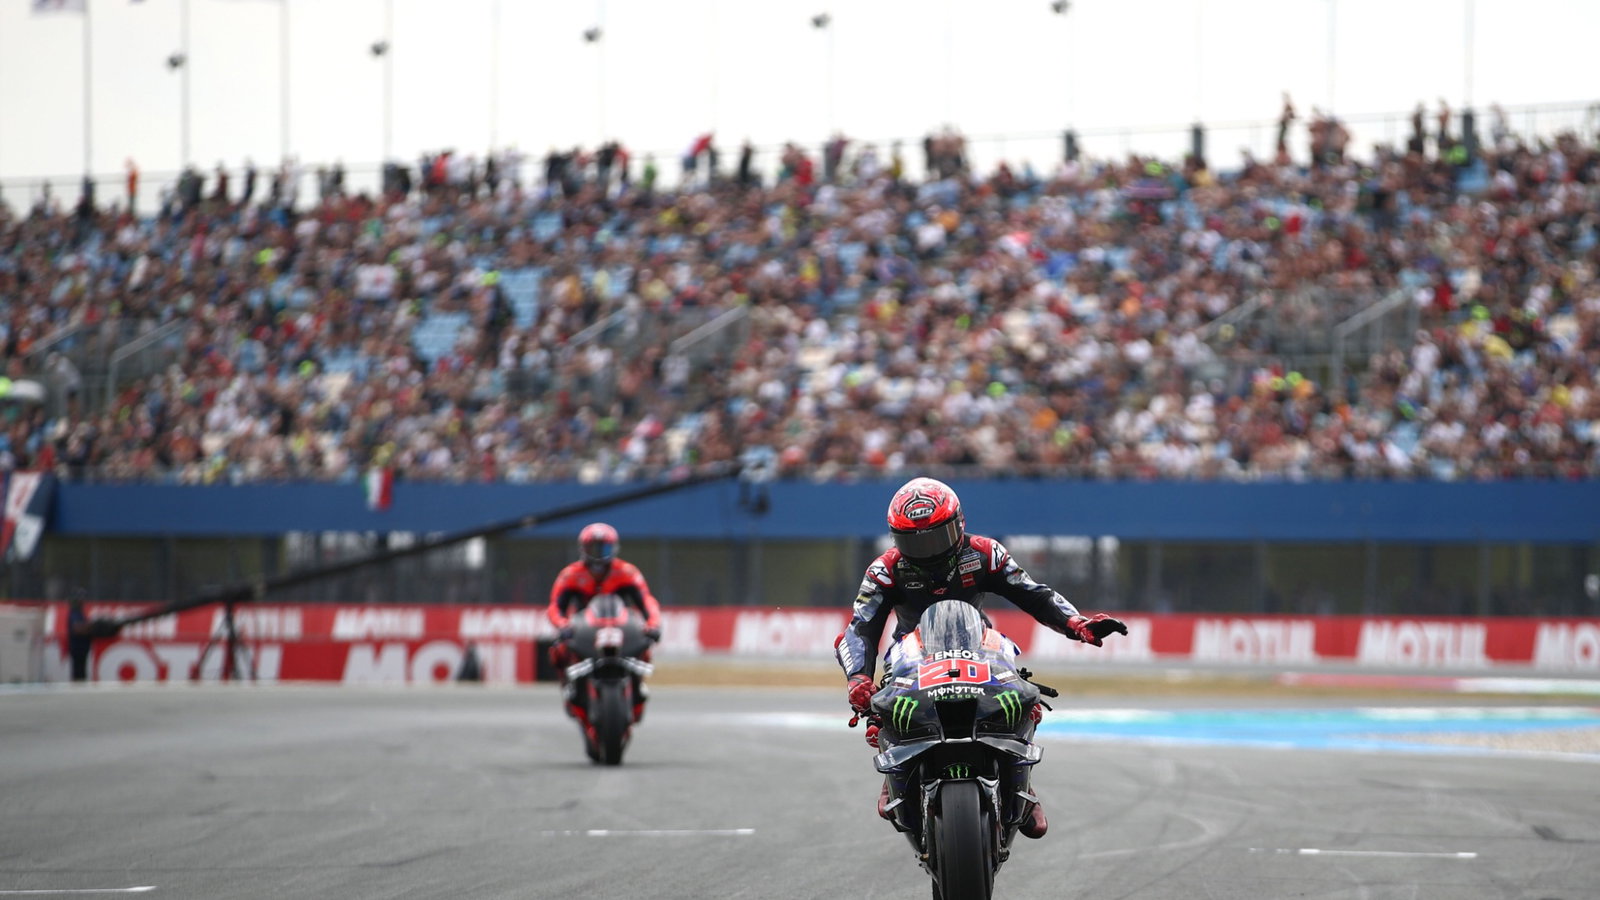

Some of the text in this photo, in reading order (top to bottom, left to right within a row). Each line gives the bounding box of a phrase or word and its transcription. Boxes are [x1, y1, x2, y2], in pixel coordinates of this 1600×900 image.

[733, 610, 848, 657] MOTUL
[1187, 618, 1317, 663] MOTUL
[1357, 620, 1488, 668] MOTUL
[935, 649, 980, 661] ENEOS
[918, 659, 991, 690] 20
[927, 685, 986, 698] MONSTER
